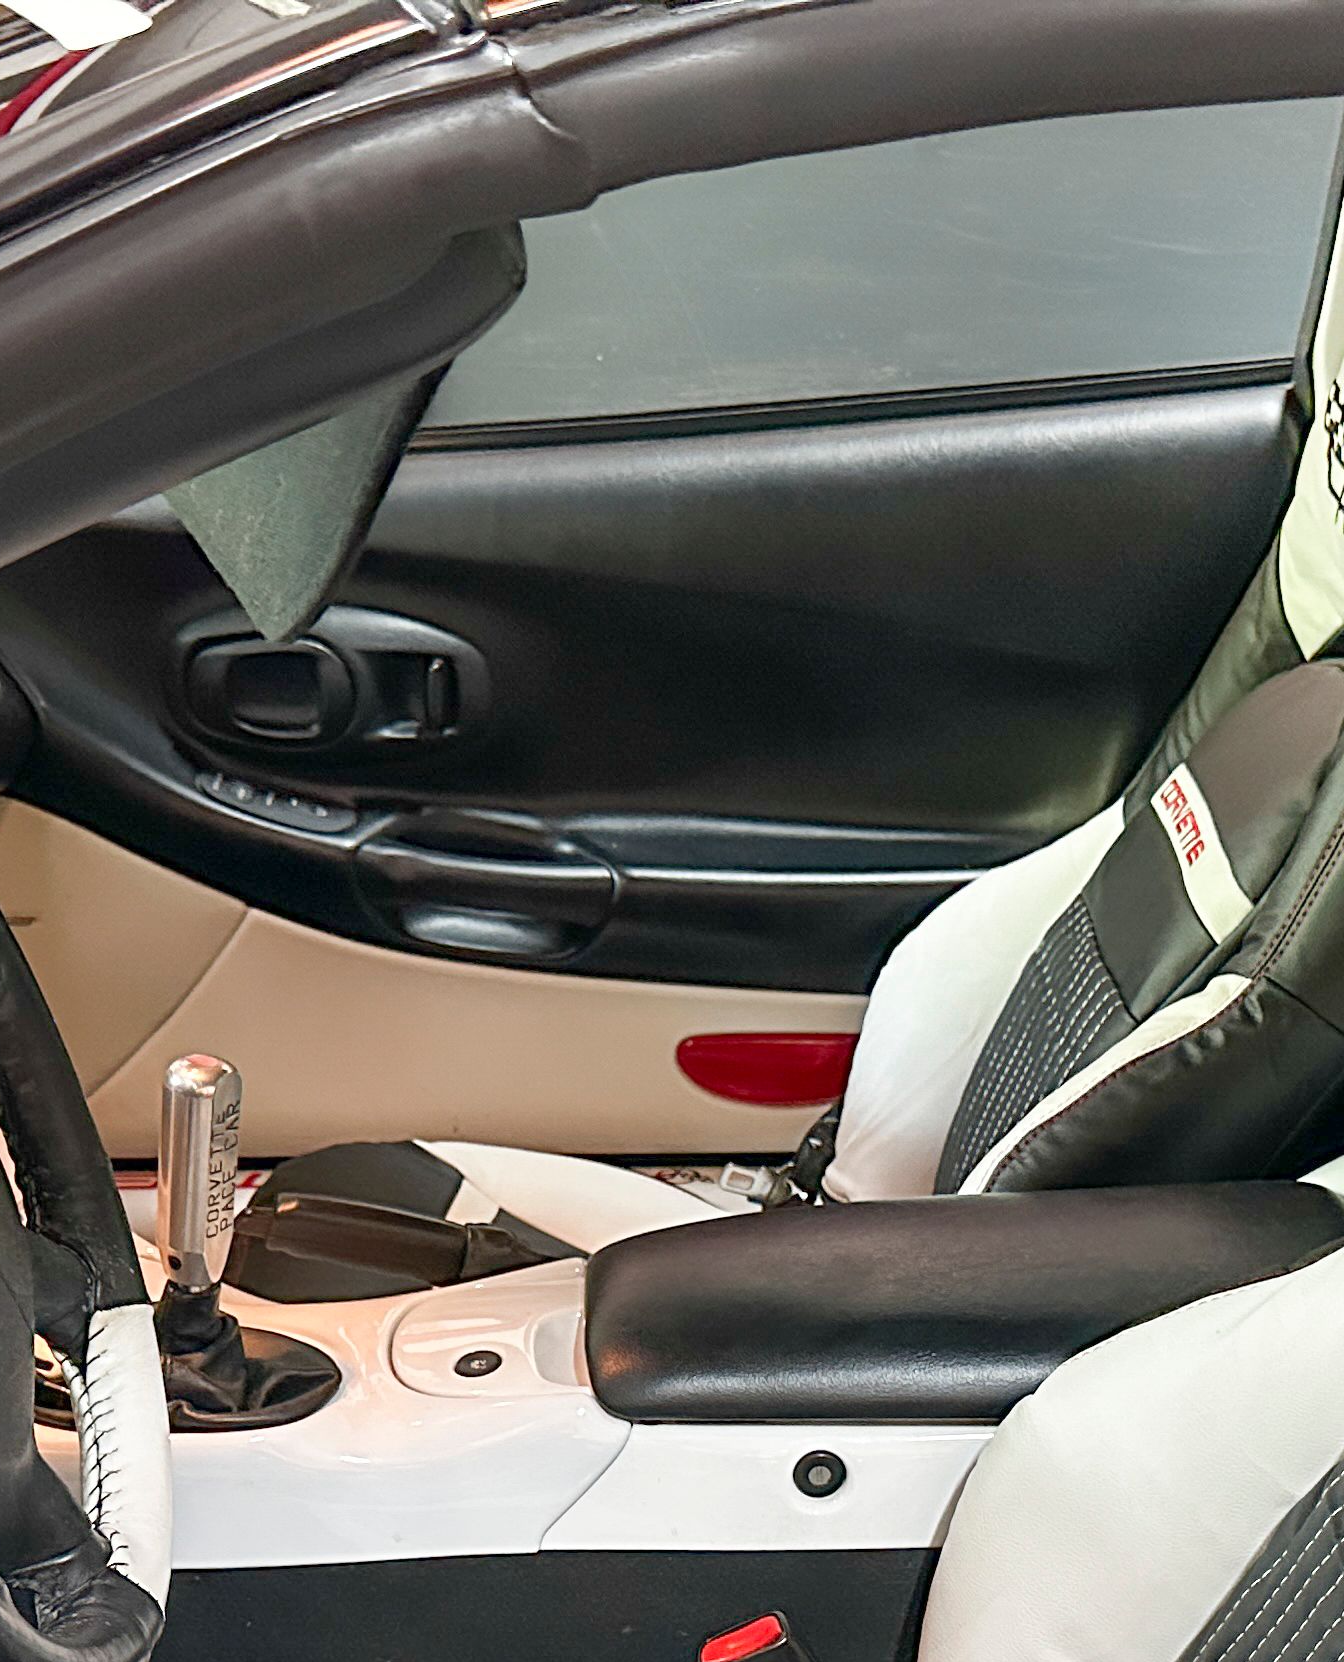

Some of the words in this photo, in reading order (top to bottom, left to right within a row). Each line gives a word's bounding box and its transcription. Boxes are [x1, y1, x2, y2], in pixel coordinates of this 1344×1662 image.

[1160, 779, 1205, 867] CORVETTE
[223, 1100, 241, 1151] CAR
[206, 1110, 226, 1239] CORVETTE
[220, 1165, 238, 1232] PACE
